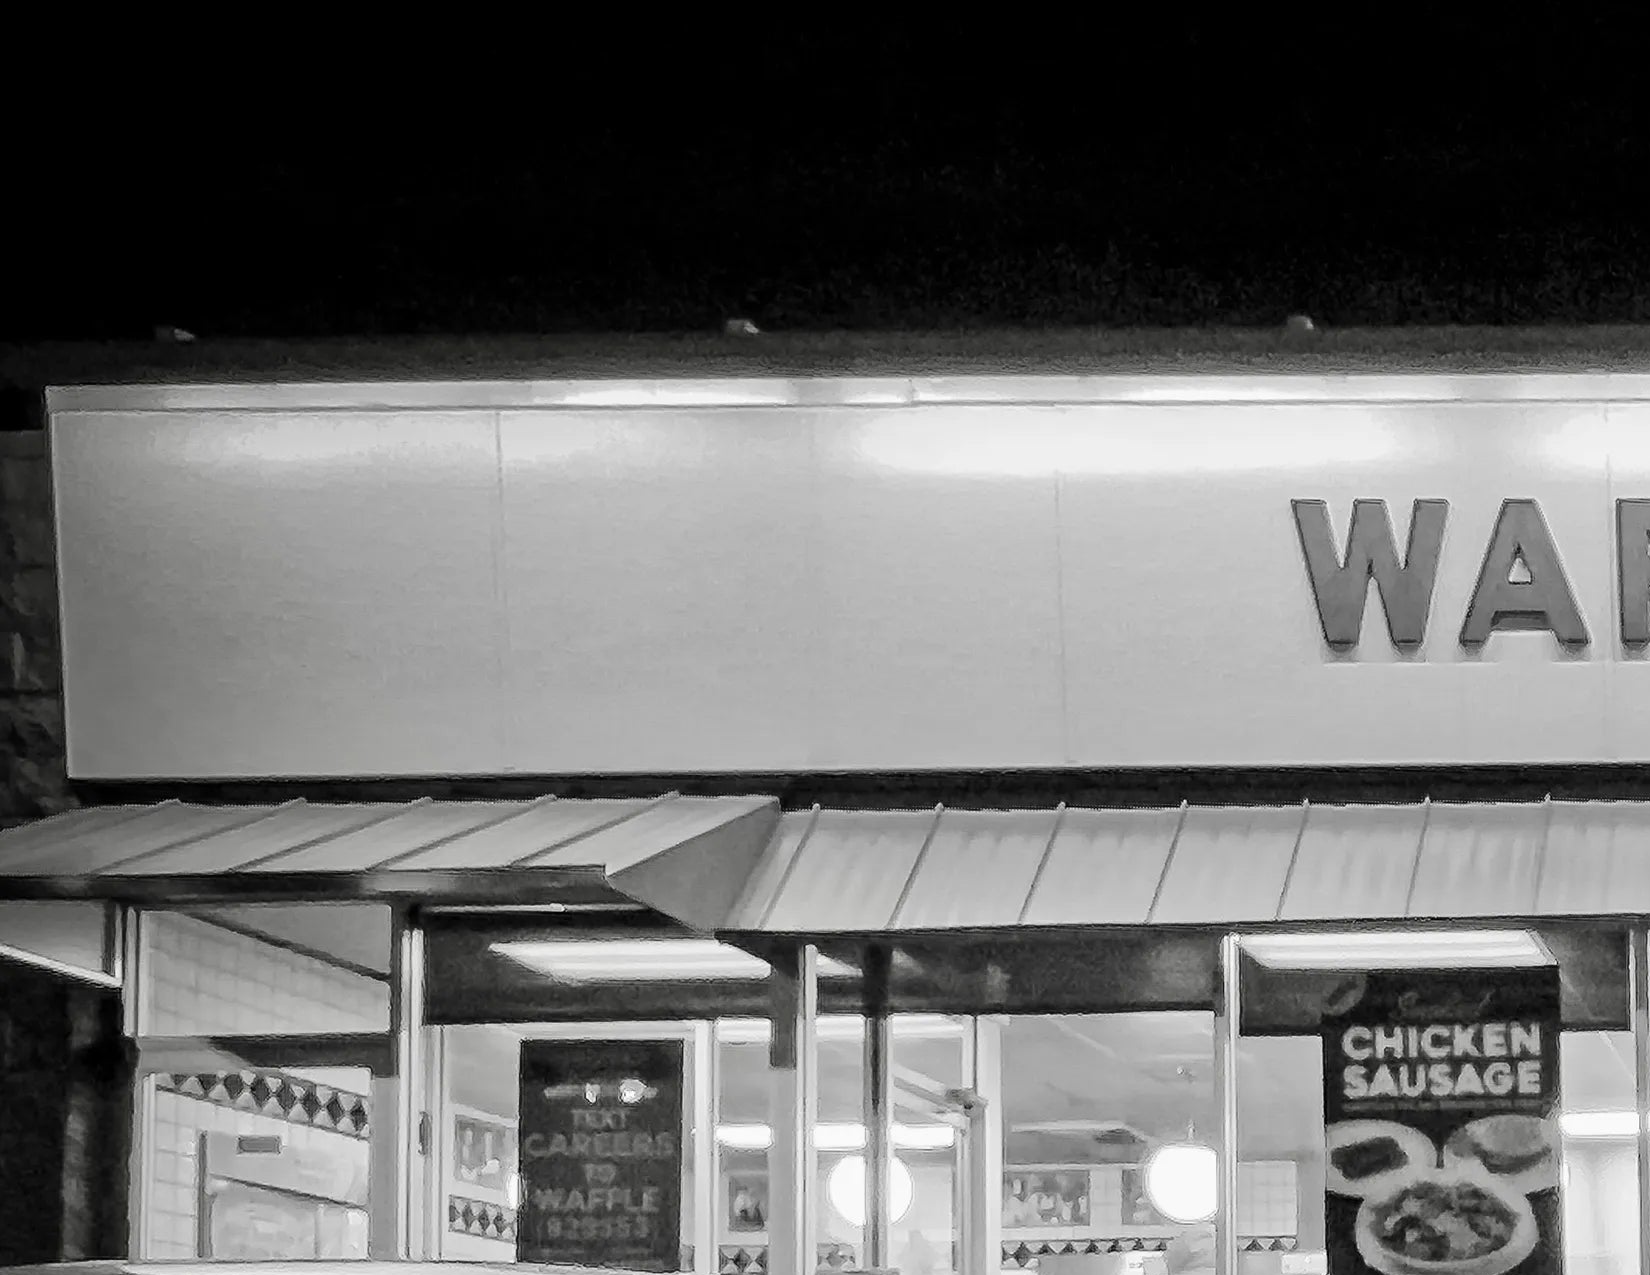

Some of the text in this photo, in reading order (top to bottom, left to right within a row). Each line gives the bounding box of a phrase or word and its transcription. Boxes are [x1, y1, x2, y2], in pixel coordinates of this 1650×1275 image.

[1342, 1022, 1542, 1060] CHICKEN
[1343, 1060, 1542, 1099] SAUSAGE
[531, 1186, 659, 1212] WAFFLE
